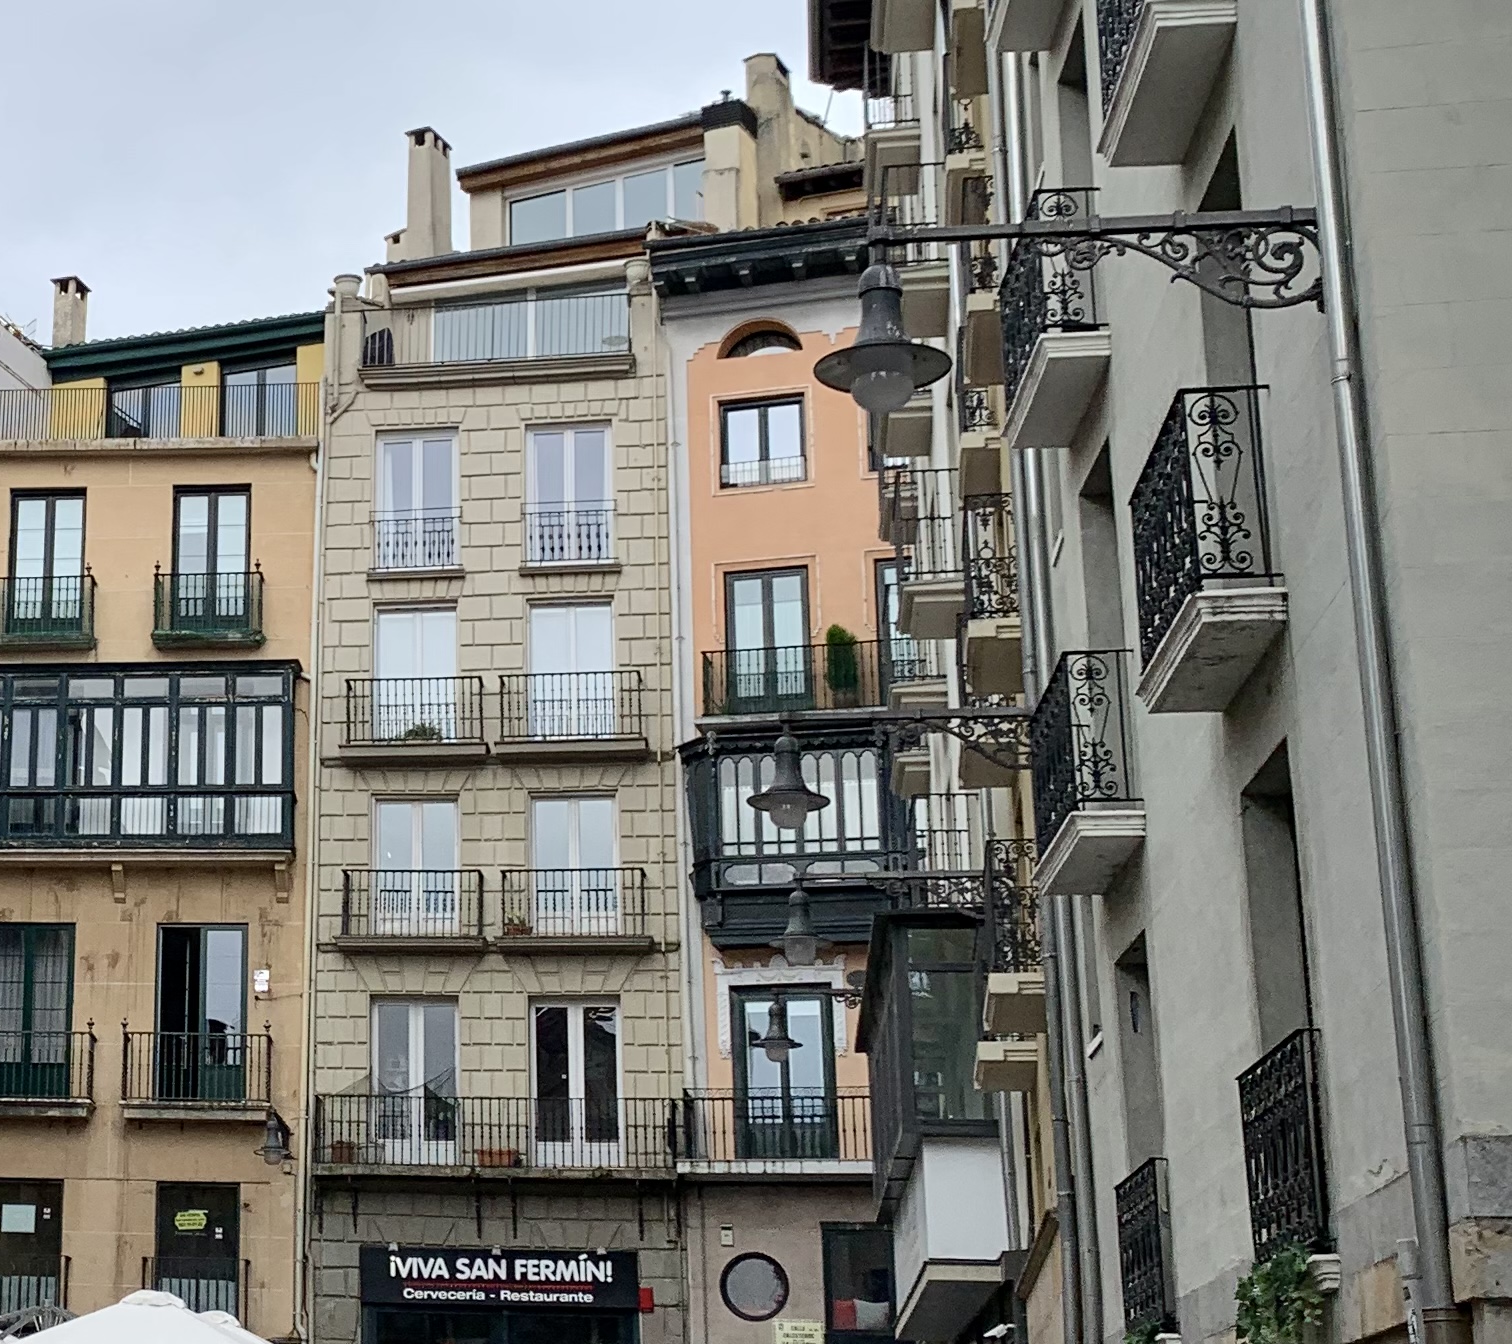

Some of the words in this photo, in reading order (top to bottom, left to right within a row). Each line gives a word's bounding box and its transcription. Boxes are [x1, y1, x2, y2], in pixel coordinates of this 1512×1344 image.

[390, 1255, 450, 1280] ¡VIVA
[455, 1258, 507, 1280] SAN
[514, 1254, 613, 1283] FERMÍN!
[403, 1288, 486, 1301] Cervecería
[500, 1290, 594, 1303] Restaurante
